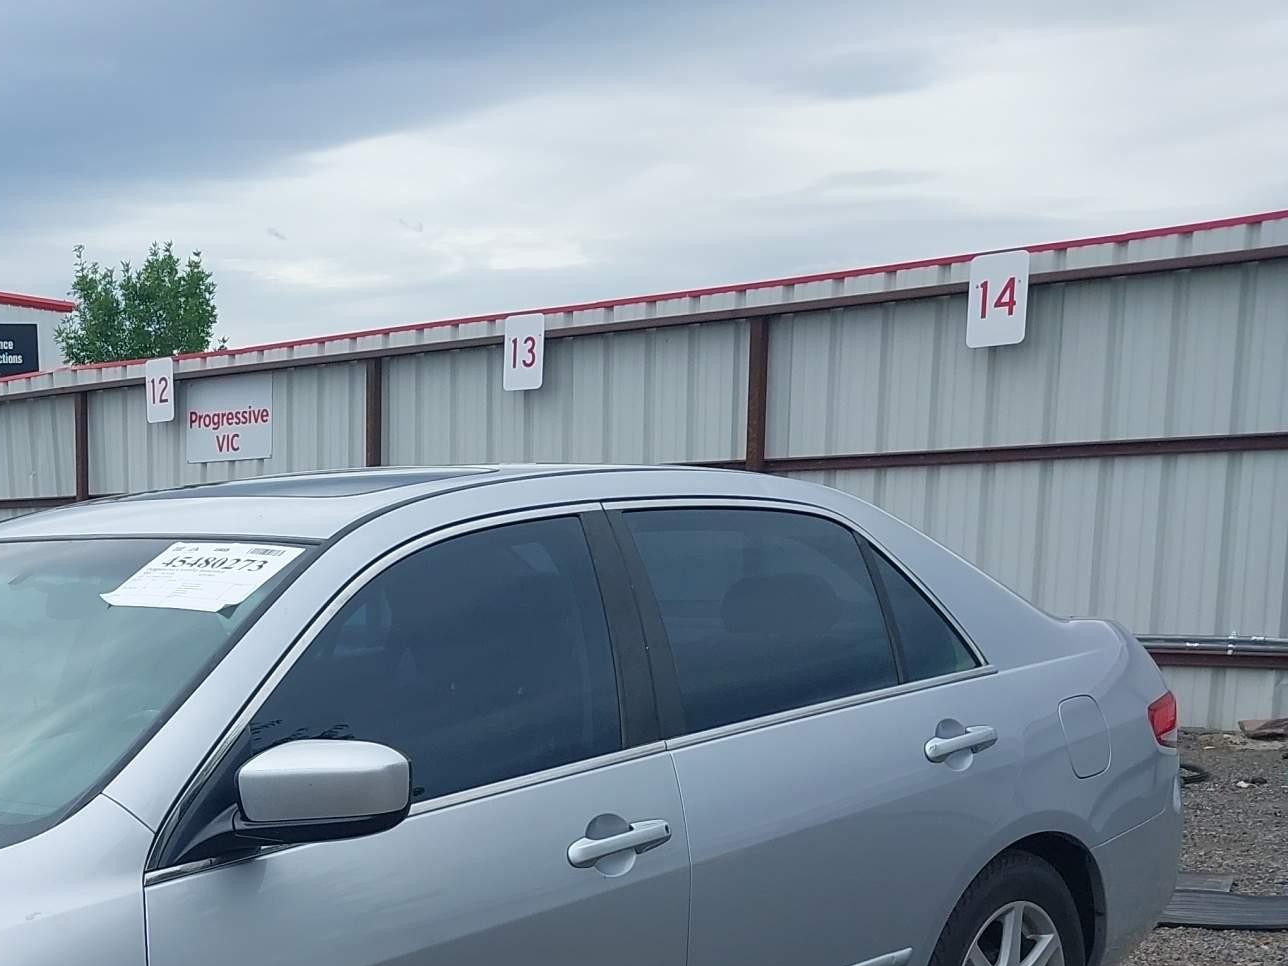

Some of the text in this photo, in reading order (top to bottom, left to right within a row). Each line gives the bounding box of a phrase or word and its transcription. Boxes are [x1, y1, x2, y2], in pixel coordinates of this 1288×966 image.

[978, 276, 1017, 319] 14
[510, 336, 537, 369] 13
[150, 376, 170, 405] 12
[188, 405, 270, 435] Progressive
[215, 434, 241, 453] VIC
[161, 555, 269, 572] 45480273
